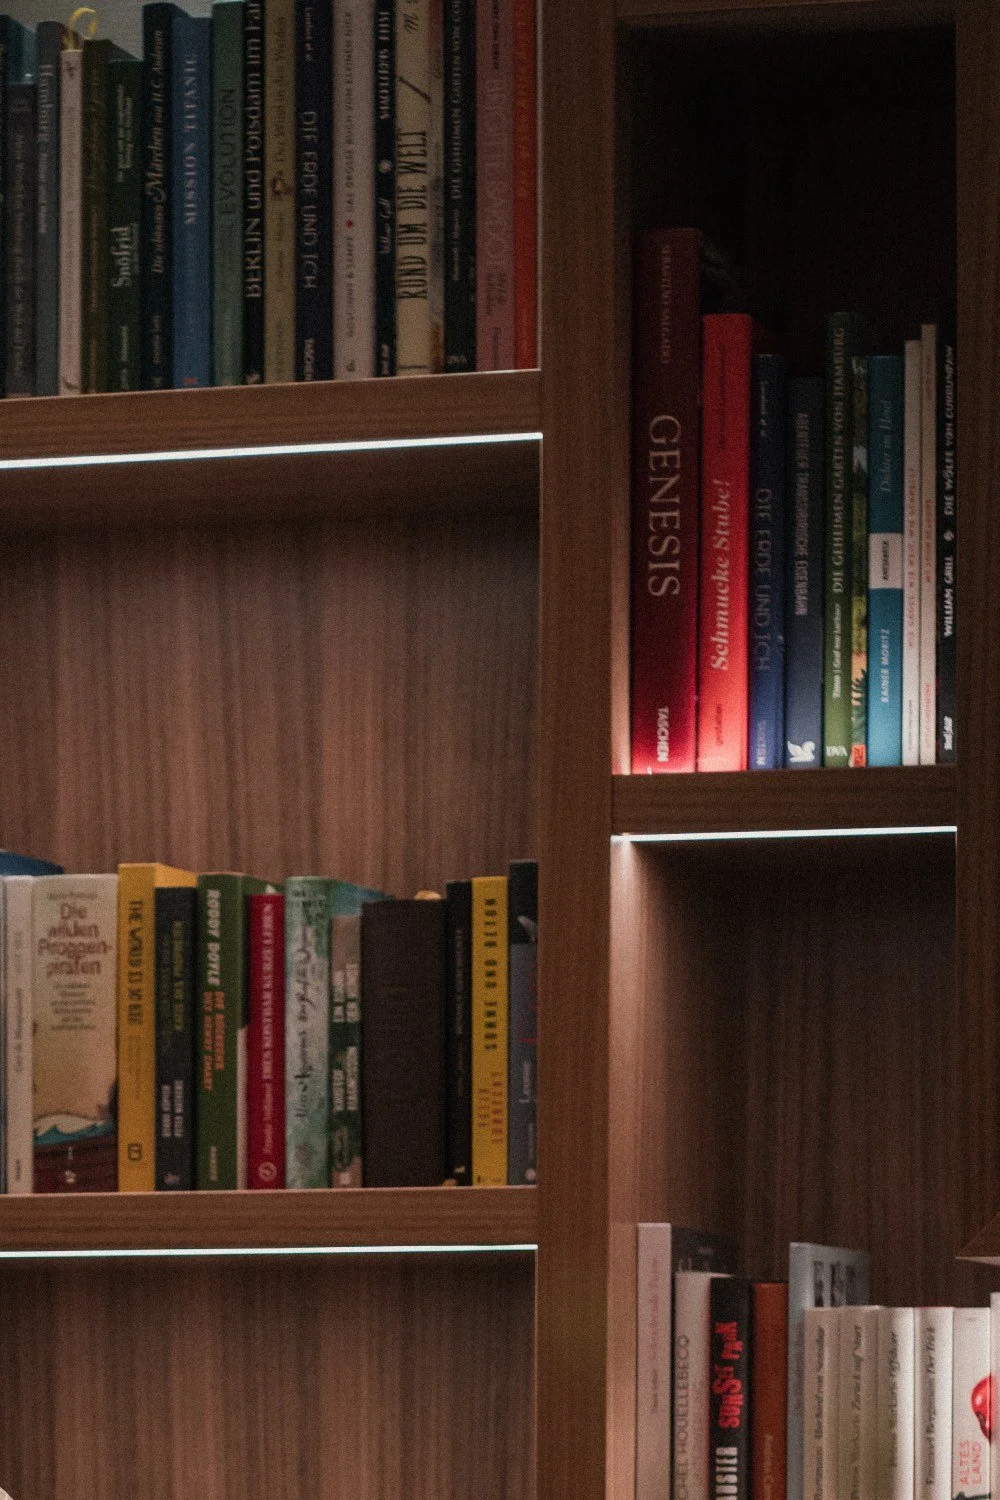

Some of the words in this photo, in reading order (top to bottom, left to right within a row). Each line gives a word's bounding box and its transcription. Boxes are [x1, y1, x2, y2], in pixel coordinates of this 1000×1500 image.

[244, 39, 263, 66] im
[183, 54, 198, 130] TITANIC
[244, 72, 263, 162] Potsdam
[301, 110, 318, 144] DIE
[218, 88, 238, 215] EVOLUTION
[301, 151, 318, 195] ERDE
[396, 128, 428, 176] WELT
[183, 142, 198, 225] MISSION
[244, 168, 263, 211] und
[396, 185, 428, 211] DIE
[301, 206, 318, 245] UND
[396, 223, 428, 246] UM
[109, 225, 134, 287] Snöfrid
[244, 218, 263, 299] BERLIN
[301, 253, 318, 289] ICH
[396, 255, 428, 300] RUND
[646, 414, 681, 598] GENESIS
[711, 479, 731, 550] Stube!
[754, 488, 773, 523] DIE
[942, 494, 956, 516] DIE
[831, 493, 846, 566] GEHEIMEN
[754, 529, 773, 579] ERDE
[942, 556, 956, 584] GRILL
[831, 570, 846, 593] DIE
[711, 554, 731, 671] Schmucke
[754, 585, 773, 627] UND
[942, 588, 956, 637] WILLIAM
[754, 634, 773, 671] ICH
[879, 629, 891, 666] MORITZ
[656, 707, 670, 762] TASCHEN
[59, 904, 87, 921] Die
[207, 889, 220, 937] RODDY
[207, 942, 220, 986] DOYLE
[676, 1335, 691, 1454] HOUELLEBECQ
[960, 1441, 970, 1486] ALTES
[971, 1442, 981, 1486] LAND
